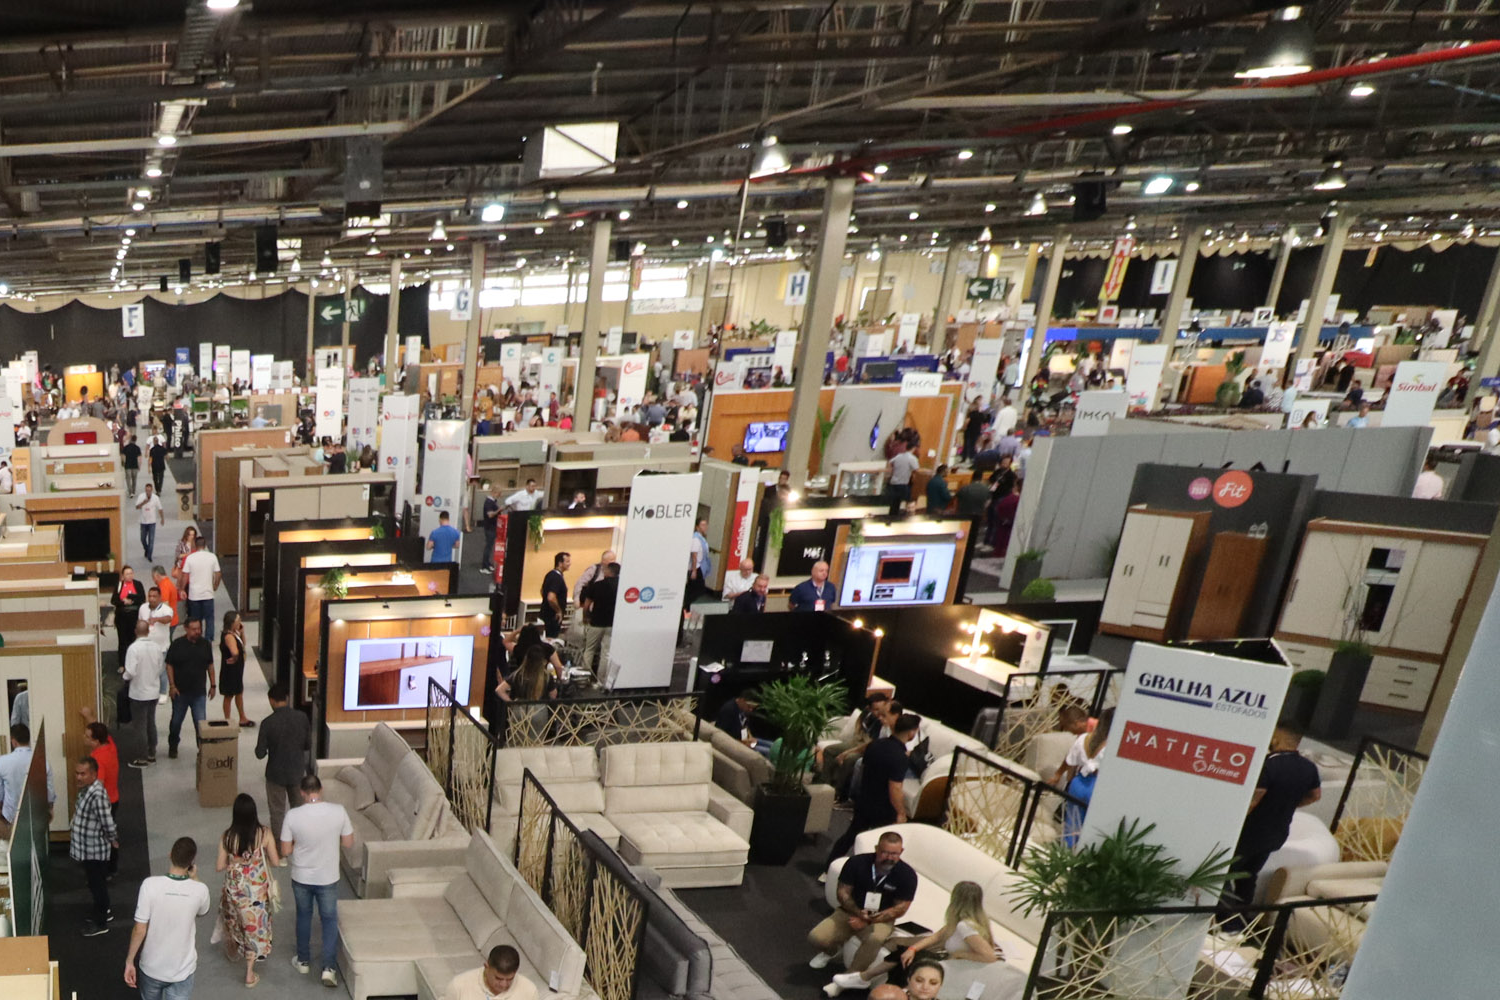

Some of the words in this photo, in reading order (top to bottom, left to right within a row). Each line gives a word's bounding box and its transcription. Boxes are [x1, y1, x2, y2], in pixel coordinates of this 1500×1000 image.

[790, 275, 805, 298] H
[456, 289, 469, 312] G
[127, 307, 139, 328] F
[1396, 382, 1438, 392] Simbal
[174, 420, 182, 448] Philco
[1219, 482, 1246, 498] Fit
[1138, 673, 1213, 699] GRALHA
[1218, 687, 1269, 710] AZUL
[1214, 702, 1267, 719] ESTOFADOS
[1125, 730, 1247, 767] MATIELO
[1206, 764, 1241, 779] Primme
